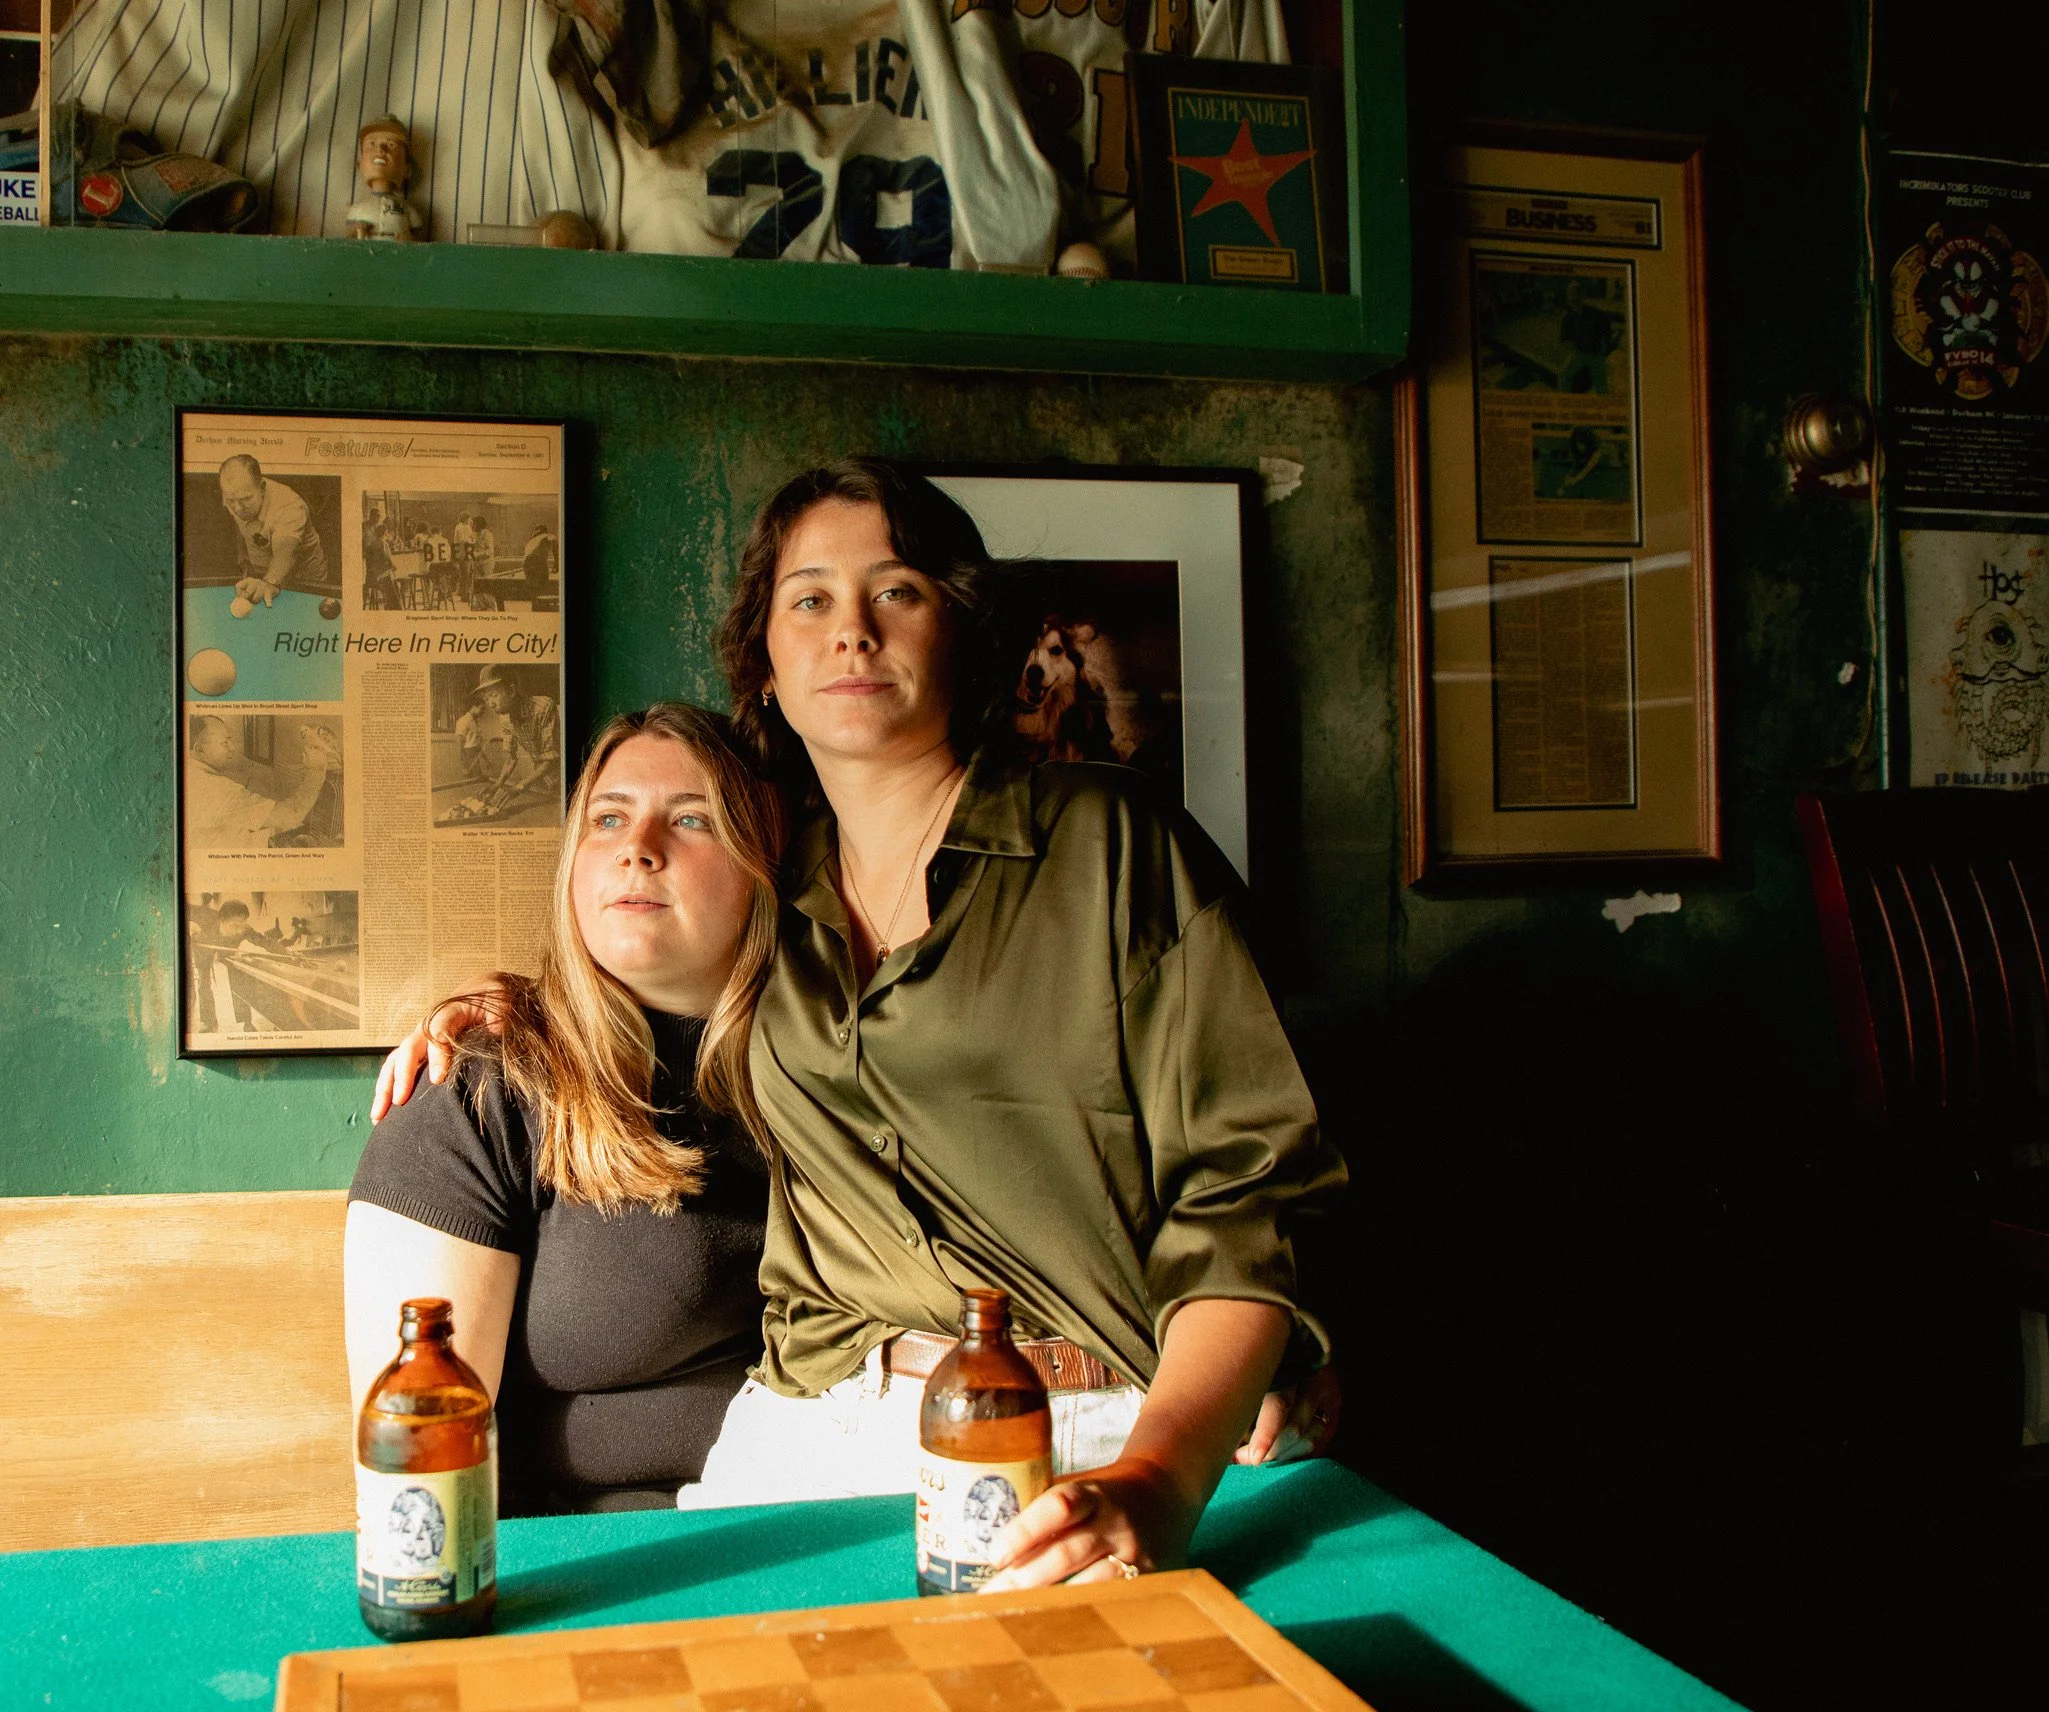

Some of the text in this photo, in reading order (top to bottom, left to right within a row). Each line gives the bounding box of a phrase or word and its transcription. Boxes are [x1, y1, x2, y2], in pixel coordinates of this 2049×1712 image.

[0, 179, 36, 198] KE
[1945, 196, 1988, 208] PRESENTS
[1506, 207, 1597, 233] BUSINESS
[259, 437, 284, 445] Herald
[424, 542, 478, 564] BEER
[273, 632, 557, 659] Right Here In River City!
[1952, 772, 2007, 785] RELEASE
